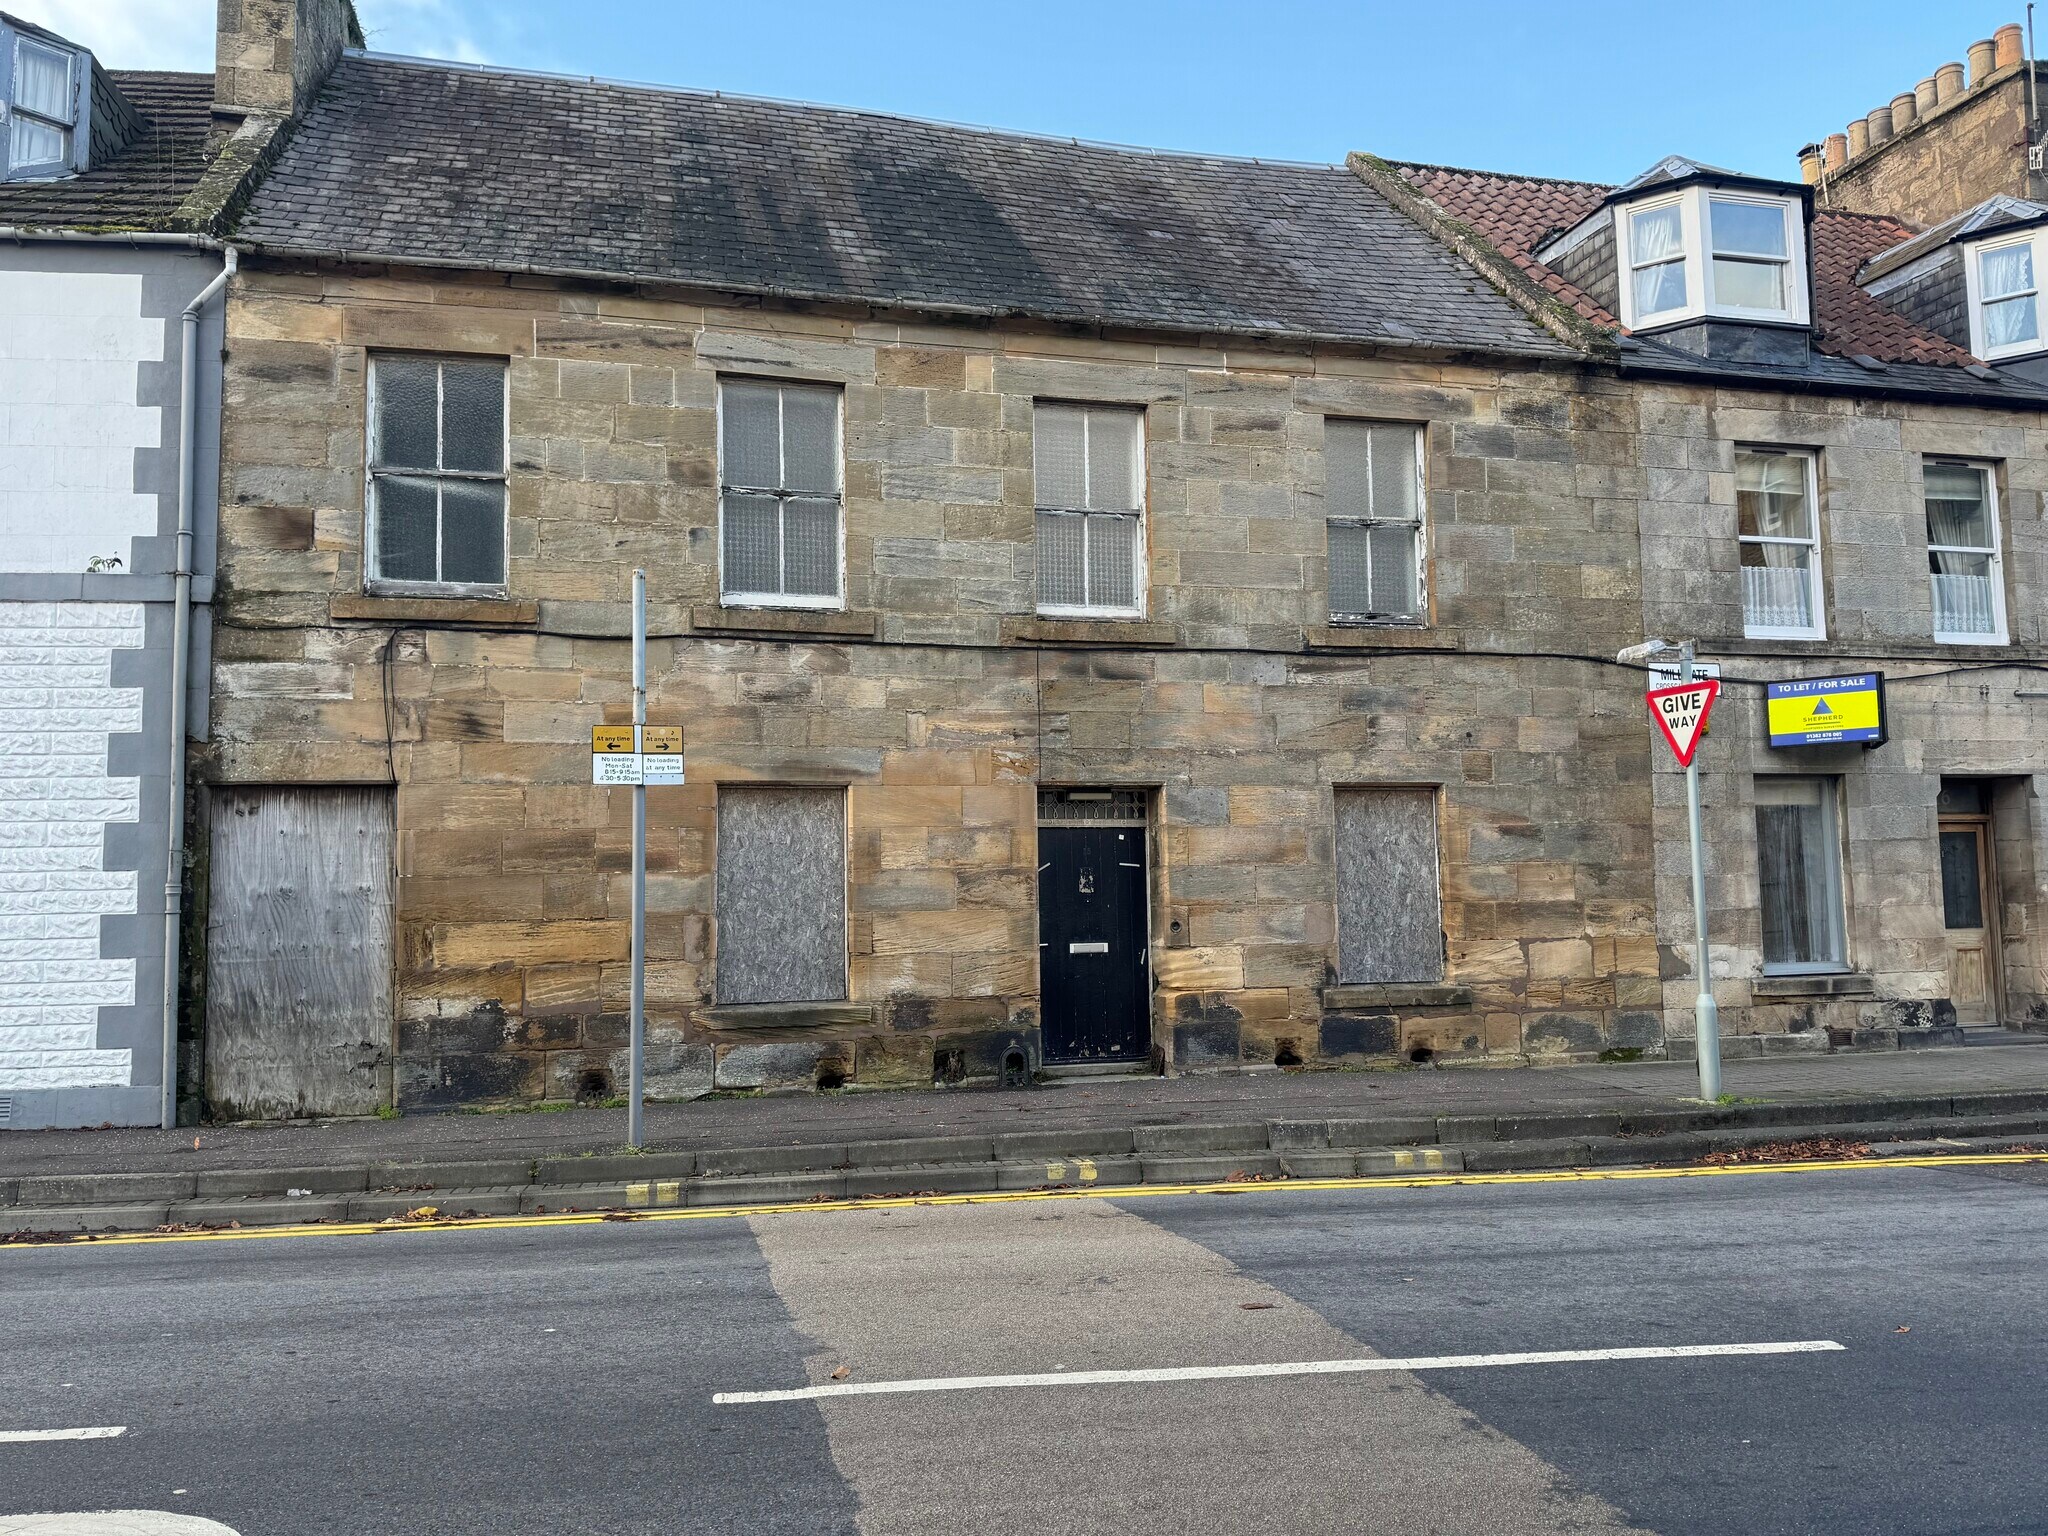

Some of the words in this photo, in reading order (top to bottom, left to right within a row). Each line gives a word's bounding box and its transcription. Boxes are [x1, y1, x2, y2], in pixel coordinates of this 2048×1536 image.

[1660, 669, 1708, 681] MILLATE
[1778, 684, 1791, 693] TO
[1794, 683, 1810, 691] LET
[1818, 680, 1838, 689] FOR
[1841, 678, 1866, 687] SALE
[1662, 693, 1701, 714] GIVE
[1669, 714, 1697, 729] WAY
[1802, 714, 1844, 722] SHEPHERD
